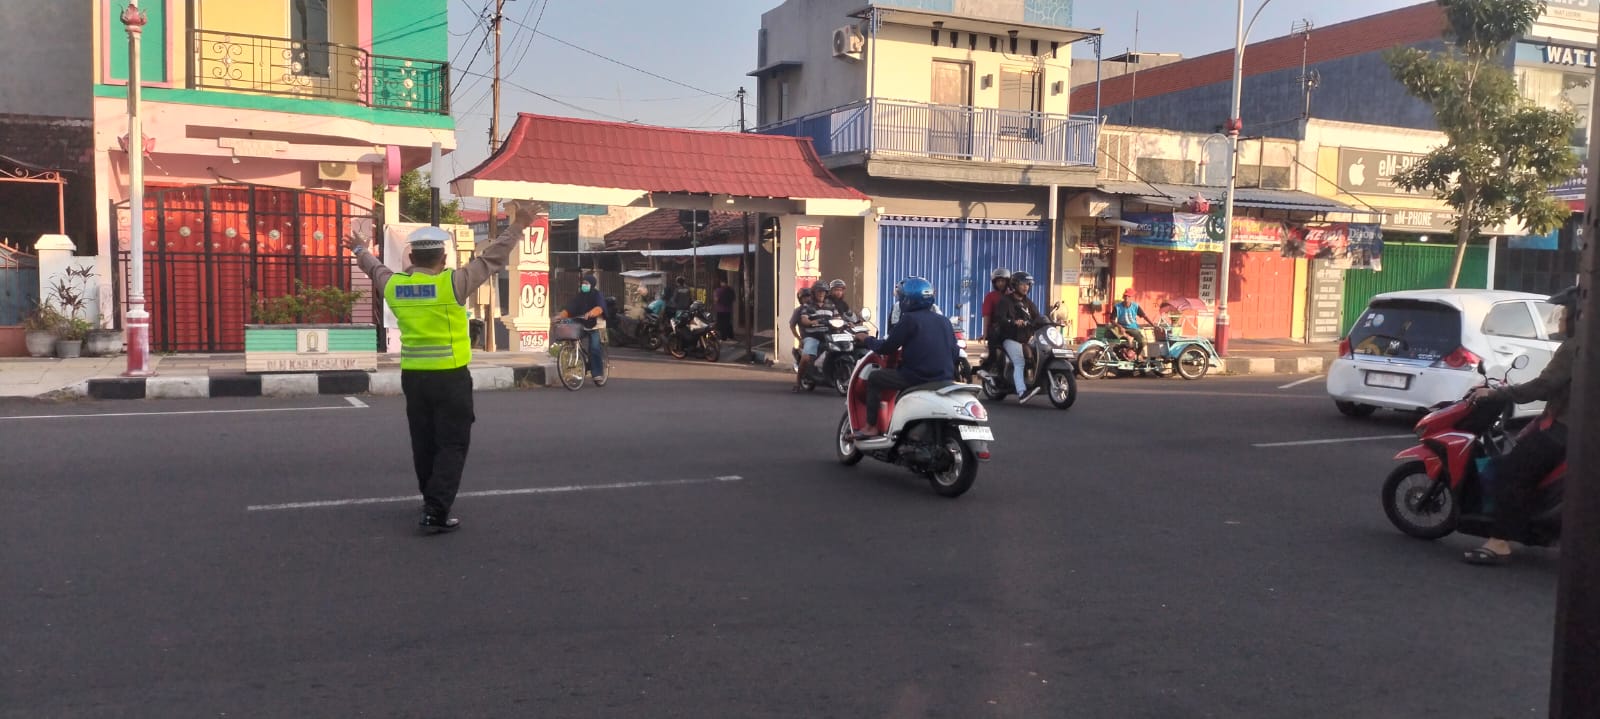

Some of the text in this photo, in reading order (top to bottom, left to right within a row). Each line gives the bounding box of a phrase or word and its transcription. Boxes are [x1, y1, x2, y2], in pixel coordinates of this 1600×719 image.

[522, 226, 545, 256] 17
[798, 235, 818, 263] 17
[395, 284, 436, 298] POLISI
[522, 284, 546, 309] 08
[522, 334, 545, 347] 1945
